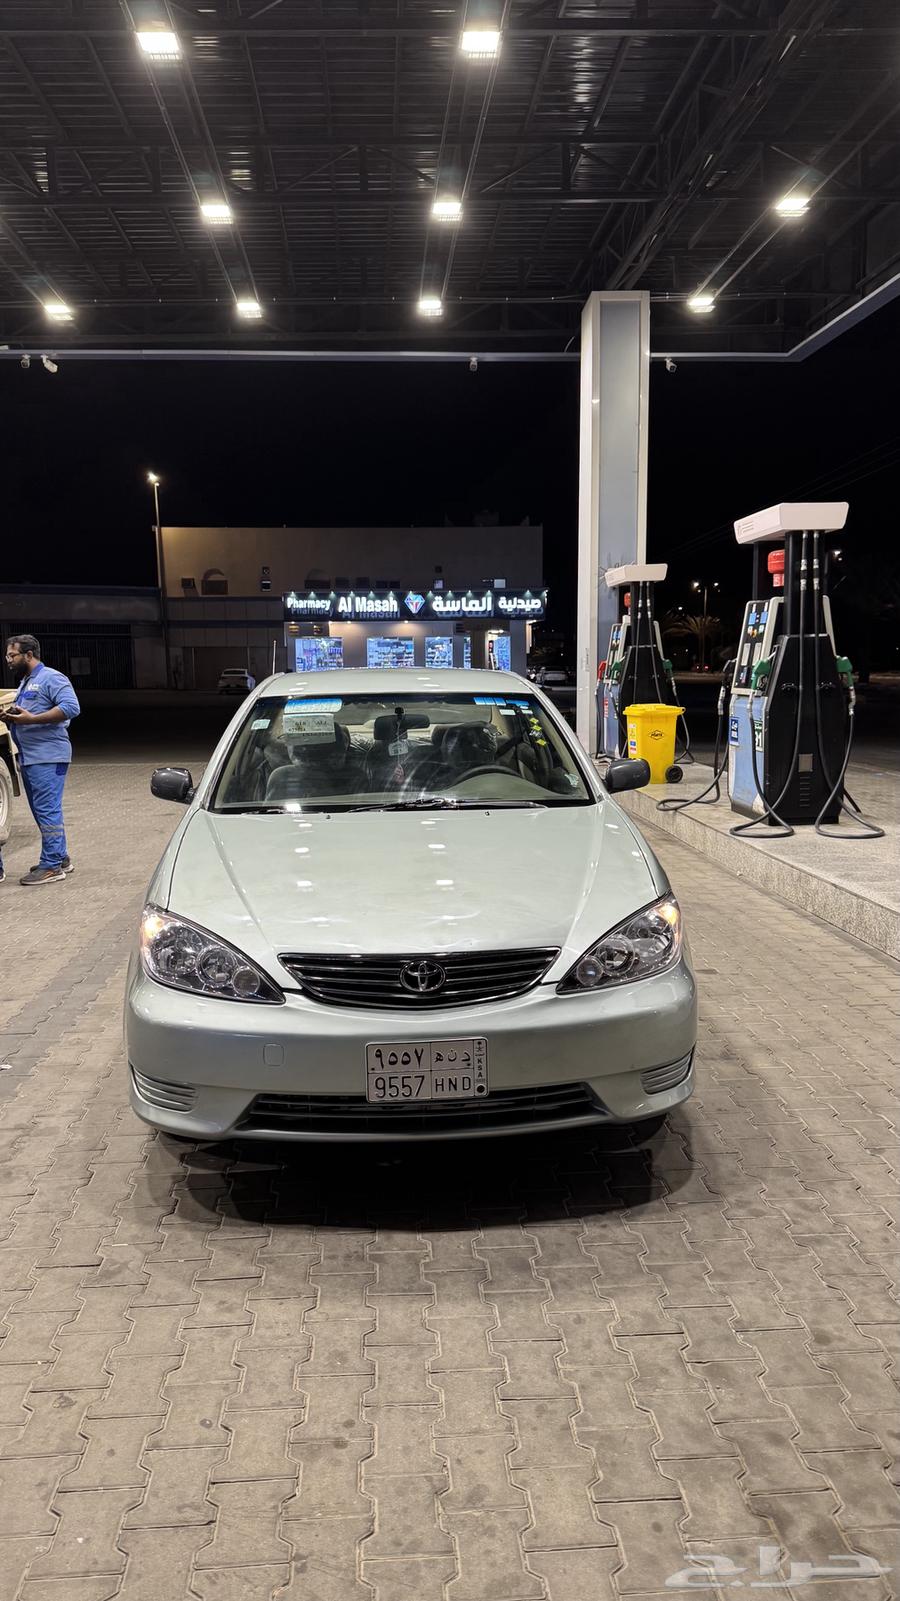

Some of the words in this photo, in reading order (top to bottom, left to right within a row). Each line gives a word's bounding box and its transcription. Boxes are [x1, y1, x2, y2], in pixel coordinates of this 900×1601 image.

[287, 597, 331, 611] Pharmacy
[338, 597, 351, 612] Al
[355, 597, 398, 612] Masah
[432, 596, 493, 612] الماسة
[498, 597, 542, 611] صيدلية
[374, 1075, 425, 1099] 9557
[435, 1076, 472, 1093] HND
